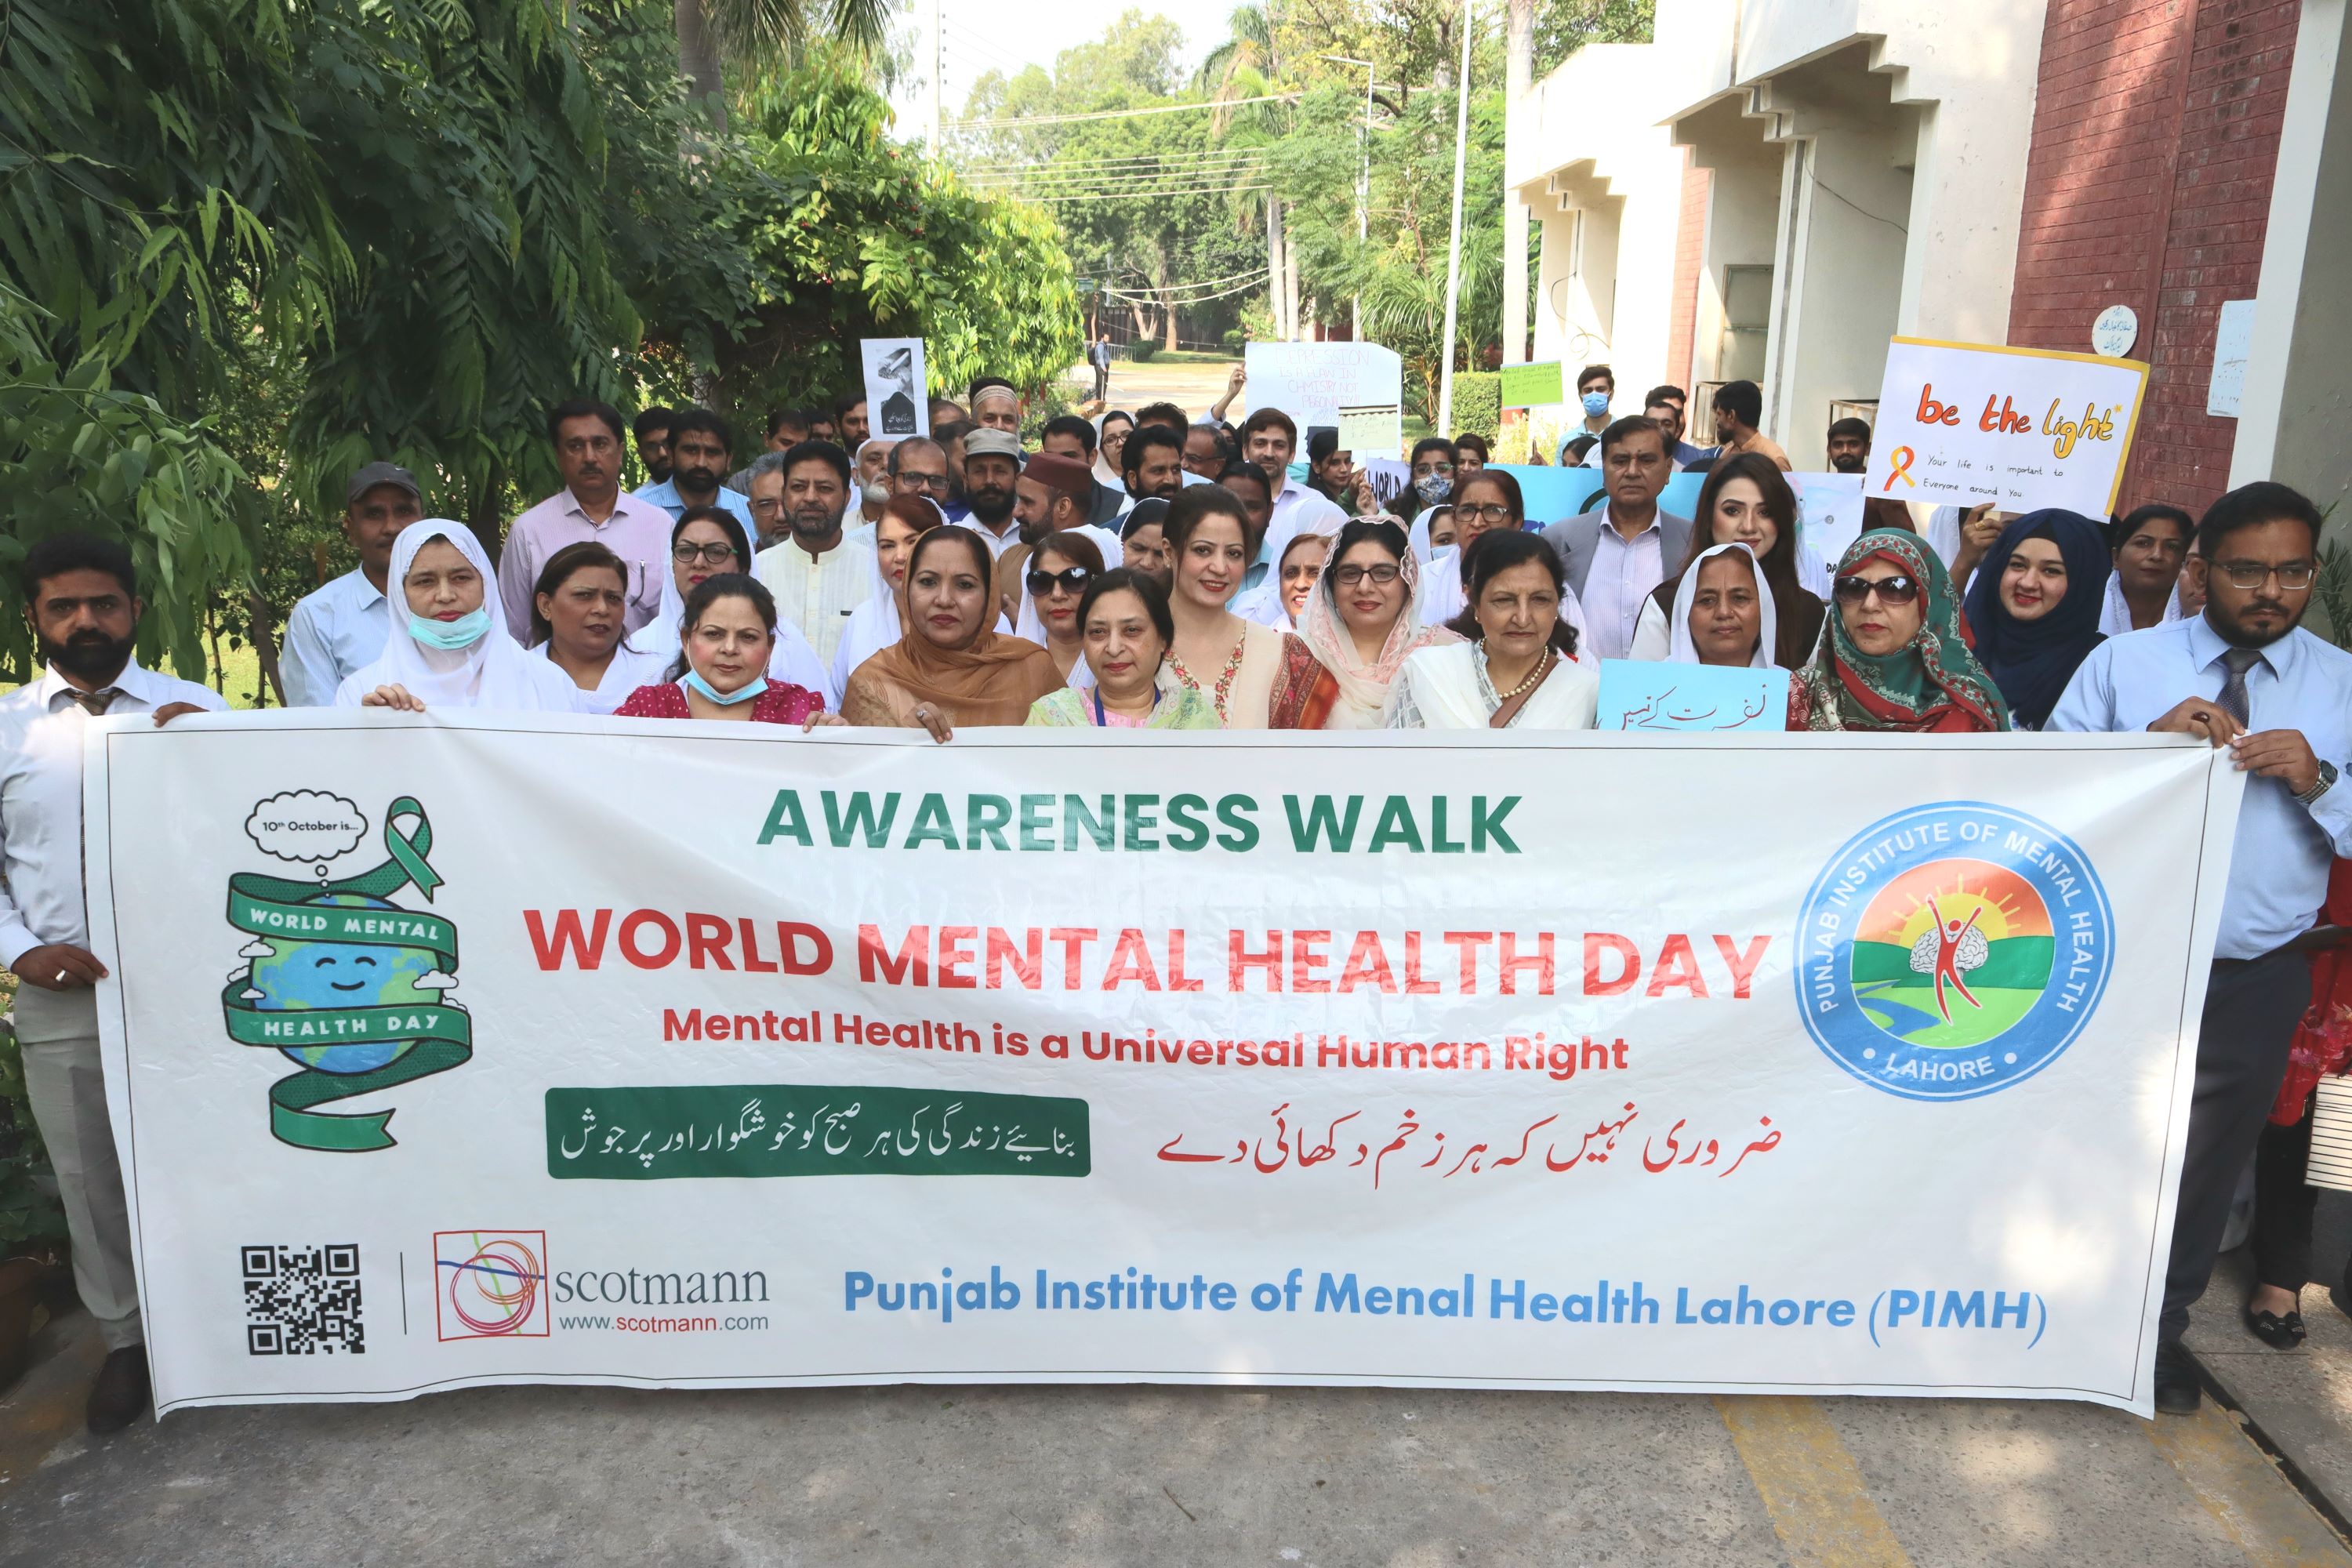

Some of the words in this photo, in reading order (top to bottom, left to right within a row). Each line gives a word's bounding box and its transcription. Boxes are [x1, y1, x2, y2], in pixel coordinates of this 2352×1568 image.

[1275, 347, 1370, 365] DEPRESSION
[1339, 368, 1356, 379] IN
[1916, 383, 1961, 426] be
[1979, 394, 2032, 434] the
[2042, 397, 2114, 459] light
[1923, 478, 1959, 492] Everyone
[1969, 486, 1998, 495] around
[1928, 455, 1947, 466] Your
[1957, 459, 1972, 470] life
[2007, 465, 2043, 477] important
[2054, 468, 2063, 477] to
[288, 821, 337, 831] October
[756, 789, 1260, 853] AWARENESS
[1282, 794, 1523, 854] WALK
[250, 907, 328, 932] WORLD
[343, 917, 440, 941] MENTAL
[1813, 912, 1840, 1014] PUNJAB
[1831, 821, 1951, 909] INSTITUTE
[1959, 820, 1999, 843] OF
[2004, 829, 2082, 909] MENTAL
[2056, 910, 2094, 1014] HEALTH
[523, 908, 833, 976] WORLD
[858, 924, 1203, 992] MENTAL
[1229, 929, 1555, 996] HEALTH
[1584, 932, 1772, 1000] DAY
[263, 1018, 368, 1037] HEALTH
[387, 1013, 441, 1032] DAY
[664, 1008, 822, 1042] Mental
[834, 1014, 981, 1054] Health
[993, 1022, 1029, 1057] is
[1040, 1034, 1070, 1059] a
[1082, 1028, 1304, 1067] Universal
[1317, 1034, 1491, 1070] Human
[1504, 1032, 1630, 1082] Right
[1884, 1051, 1997, 1082] LAHORE
[658, 1123, 694, 1152] اور
[797, 1104, 830, 1150] کو
[824, 1102, 861, 1156] صبح
[862, 1128, 891, 1158] ہر
[896, 1105, 931, 1156] کی
[928, 1101, 1000, 1156] زندگی
[1156, 1133, 1248, 1164] دے
[1254, 1102, 1368, 1174] دکھائی
[1374, 1108, 1446, 1190] زخم
[1492, 1113, 1559, 1168] کہ
[1546, 1102, 1639, 1174] نہیں
[1643, 1116, 1783, 1178] ضروری
[1442, 1133, 1489, 1178] ہر
[555, 1267, 770, 1305] scotmann
[845, 1265, 1020, 1323] Punjab
[1036, 1266, 1237, 1311] Institute
[1251, 1267, 1303, 1312] of
[1314, 1272, 1474, 1318] Menal
[1490, 1279, 1660, 1324] Health
[1675, 1284, 1856, 1327] Lahore
[1869, 1290, 2046, 1349] (PIMH)
[559, 1314, 770, 1334] www.scotmann.com
